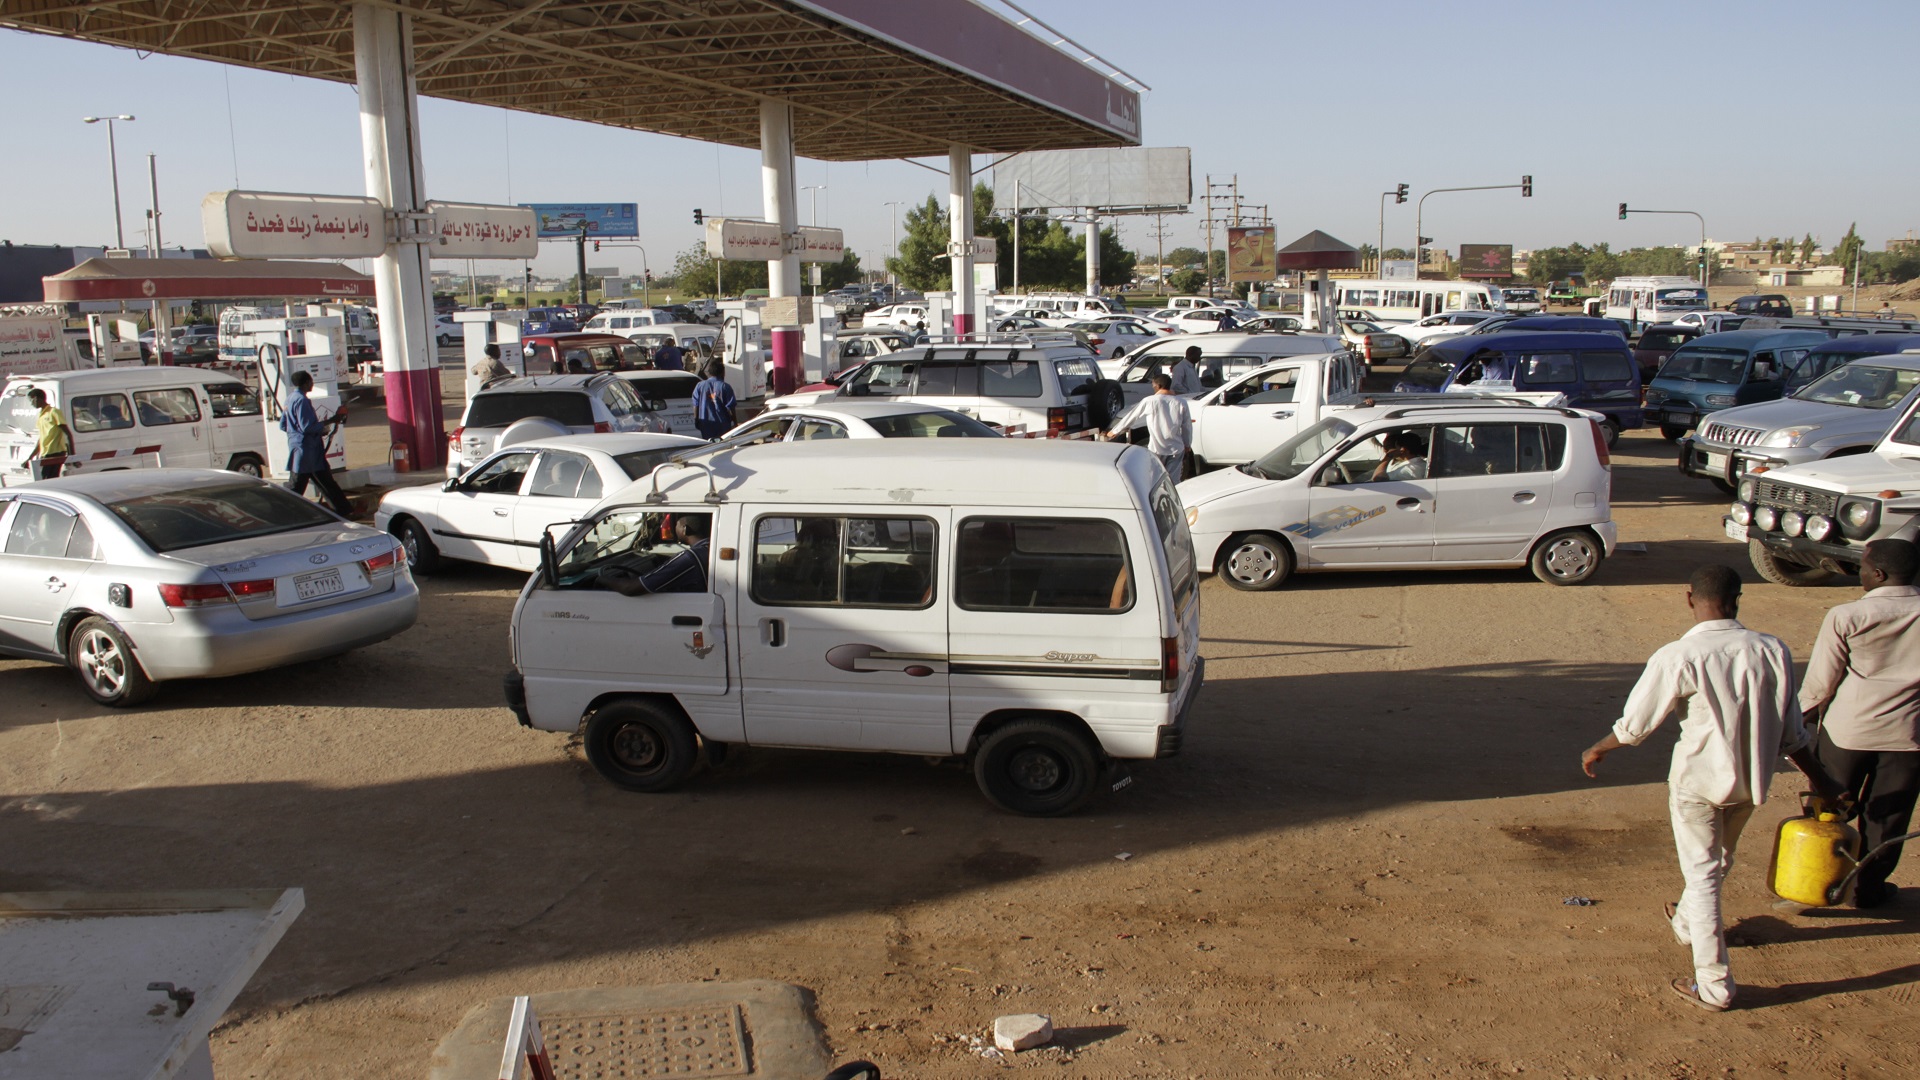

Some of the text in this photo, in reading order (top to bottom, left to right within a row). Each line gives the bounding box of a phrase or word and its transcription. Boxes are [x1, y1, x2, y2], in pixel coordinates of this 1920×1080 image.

[246, 211, 370, 240] وأما بنعمة ربك فحدث
[475, 222, 492, 241] قوة
[492, 224, 505, 242] ولا
[506, 225, 523, 243] حول
[524, 225, 531, 238] لا
[1046, 651, 1096, 663] Super
[1112, 775, 1132, 792] TOYOTA
